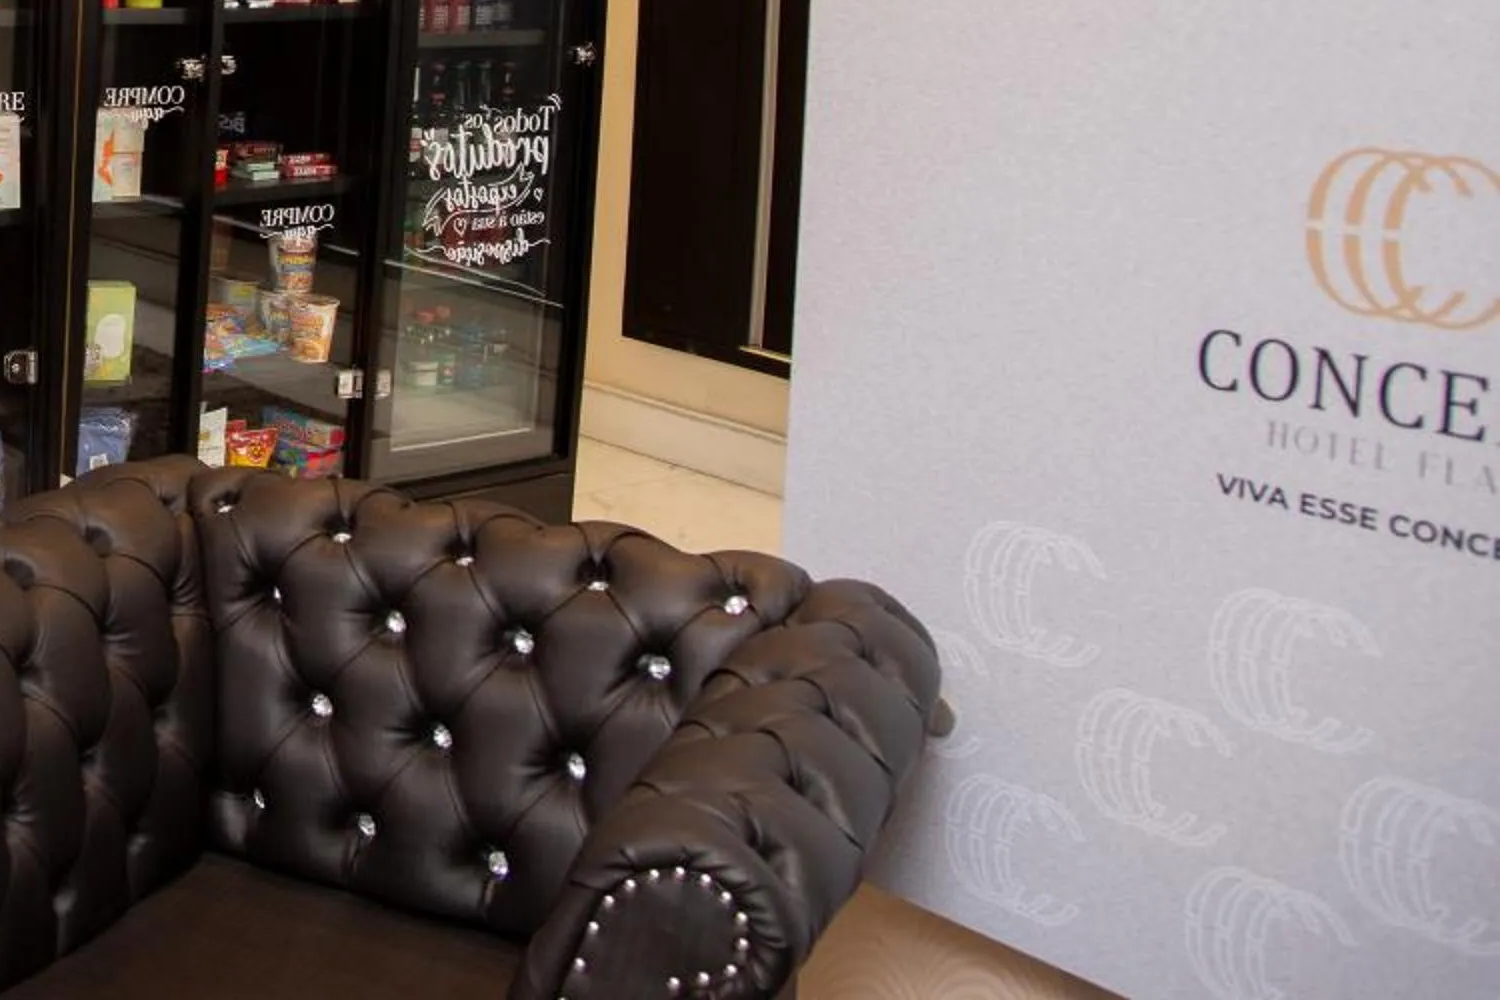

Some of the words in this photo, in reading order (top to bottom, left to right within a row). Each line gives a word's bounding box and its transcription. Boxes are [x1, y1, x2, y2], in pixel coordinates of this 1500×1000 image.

[1266, 421, 1392, 471] HOTEL
[1217, 472, 1290, 511] VIVA
[1299, 493, 1380, 531] ESSE
